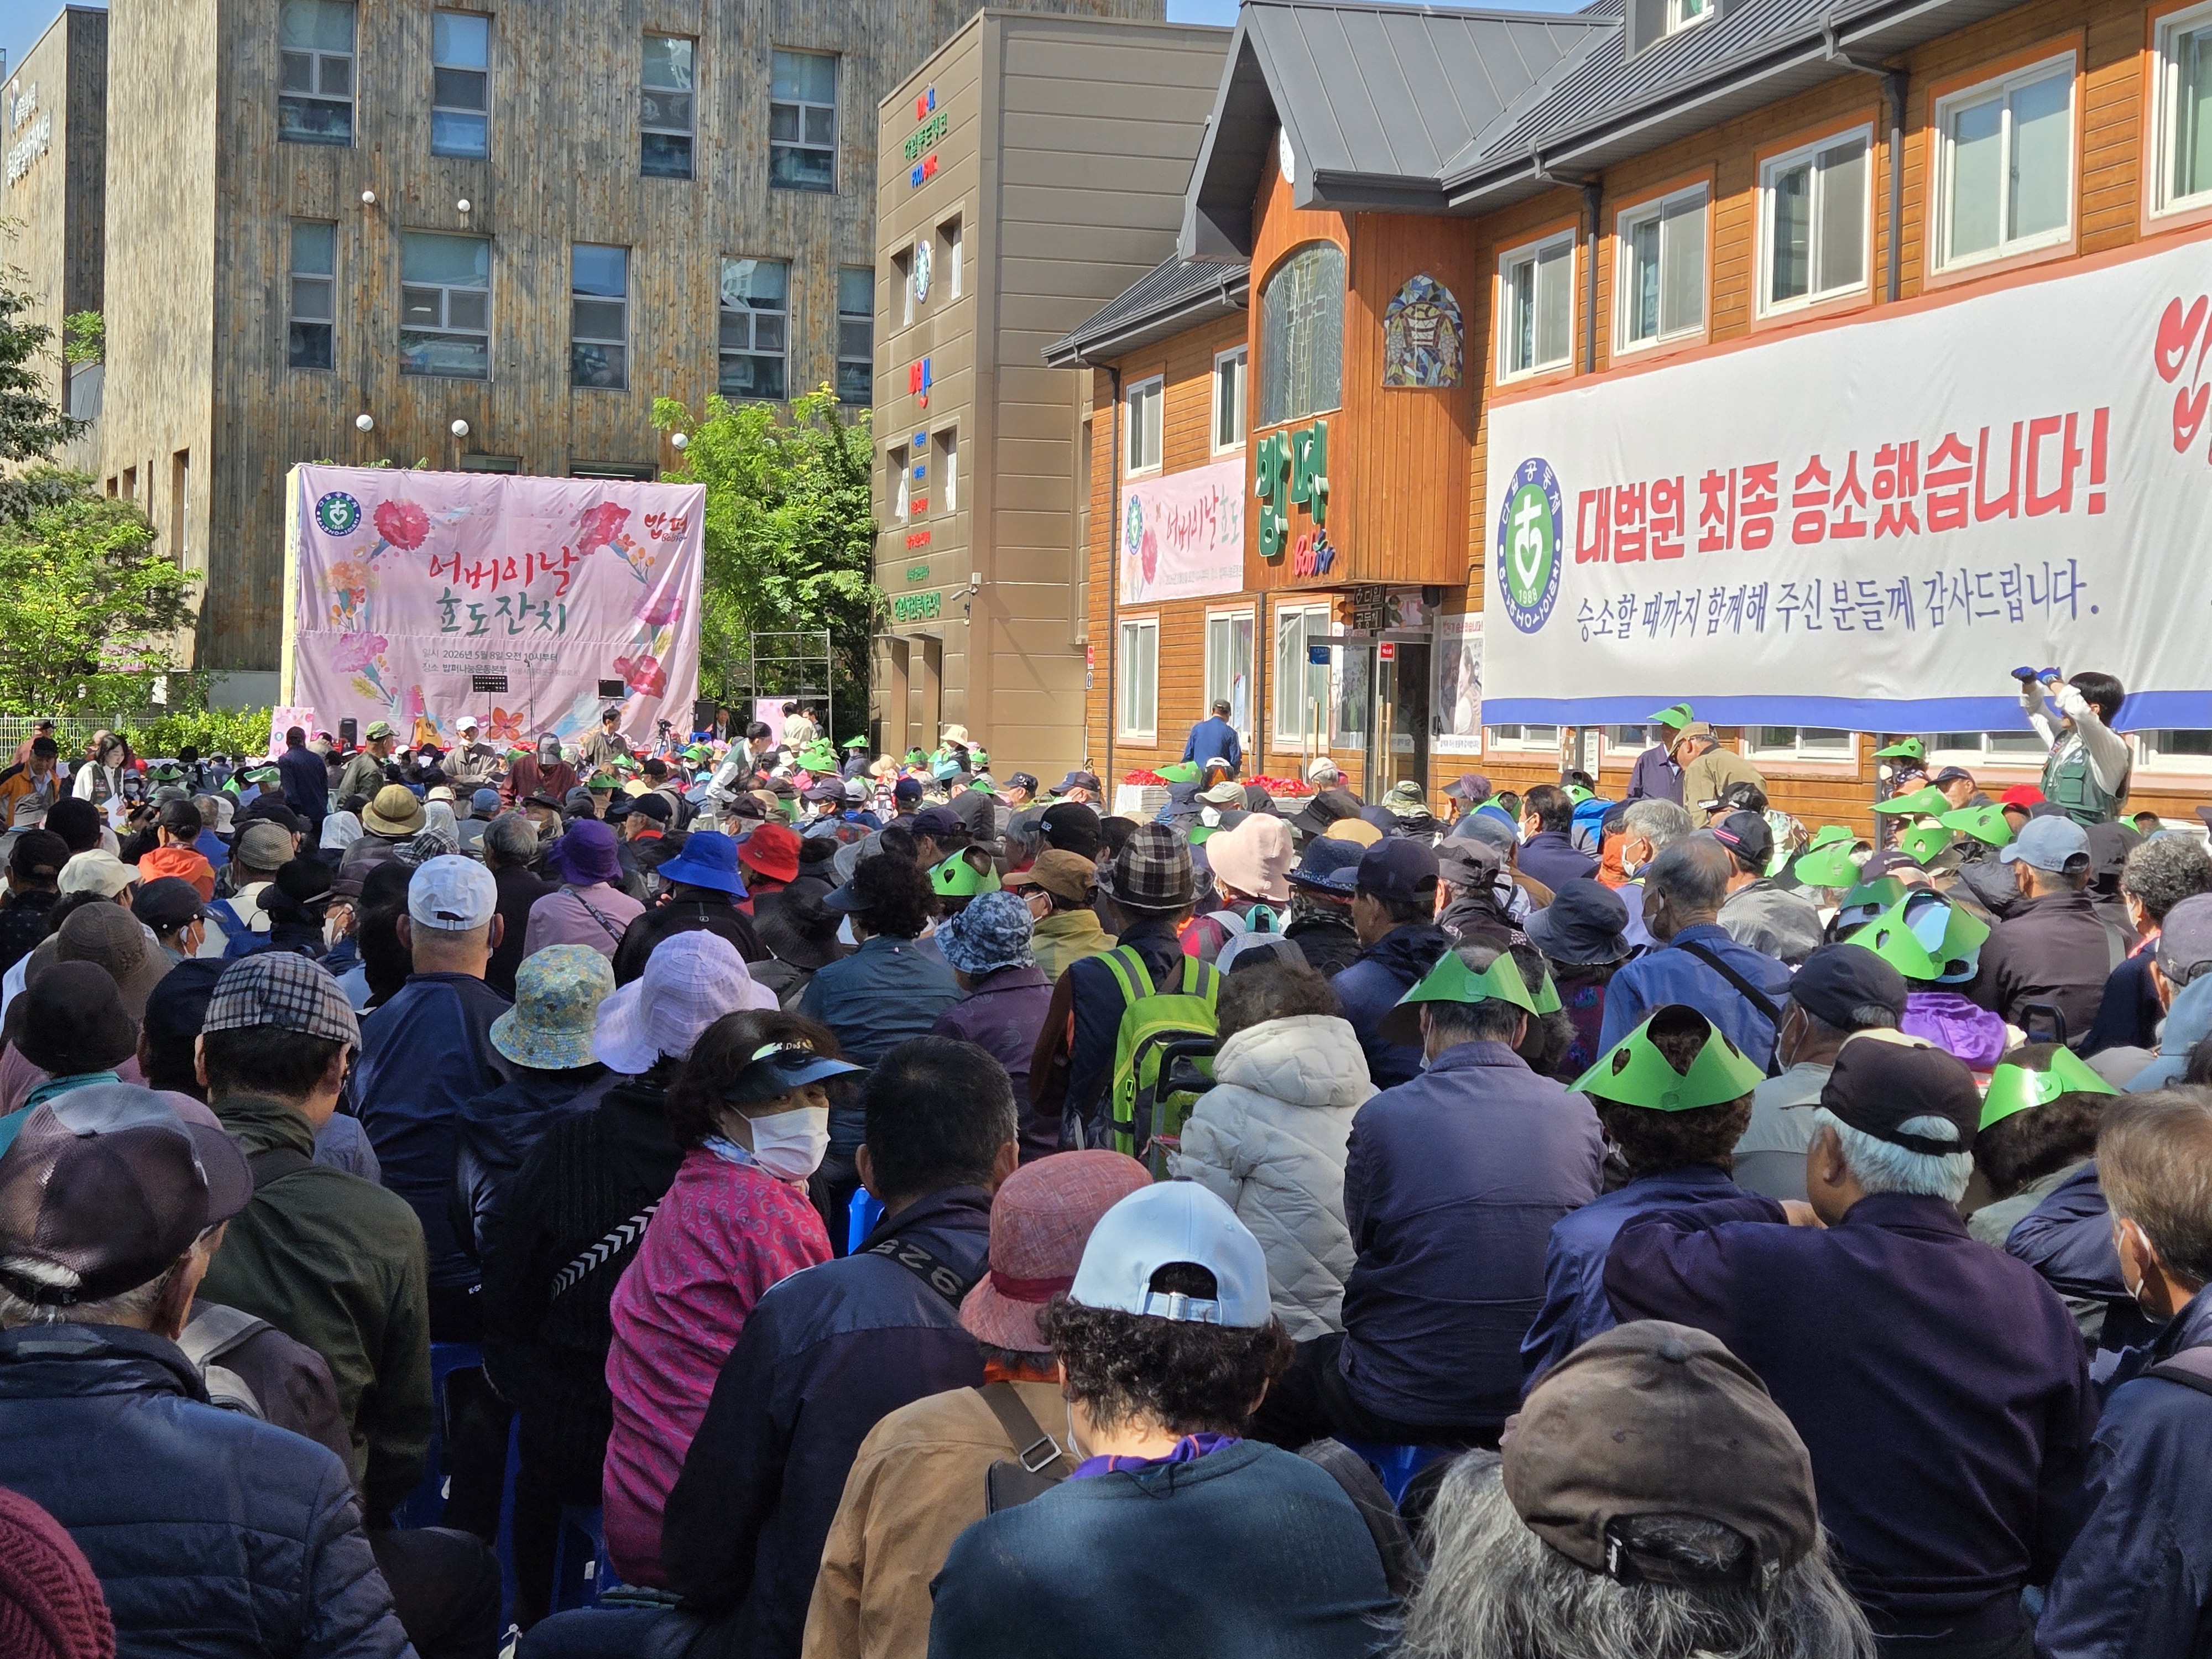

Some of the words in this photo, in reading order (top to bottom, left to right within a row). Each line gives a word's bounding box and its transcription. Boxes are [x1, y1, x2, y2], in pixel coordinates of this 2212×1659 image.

[1255, 420, 1329, 557] 밥퍼
[1502, 461, 1561, 524] 다일공동체
[1575, 476, 1684, 565] 대법원
[1698, 461, 1778, 552] 최종
[1791, 406, 2110, 545] 승소했습니다!
[430, 545, 580, 597] 어버이날
[1364, 586, 1382, 603] 다일
[1519, 587, 1538, 604] 1988
[437, 586, 567, 638] 효도잔치
[1356, 611, 1379, 629] 공동체
[1577, 593, 1637, 642] 승소할
[1642, 588, 1701, 639] 때까지
[1707, 581, 1768, 636] 함께해
[1775, 578, 1822, 633] 주신
[1830, 575, 1915, 632] 분들께
[1923, 558, 2099, 628] 감사드립니다.
[442, 650, 473, 660] 2026년
[474, 651, 488, 660] 5월
[489, 651, 503, 660] 8일
[505, 652, 521, 661] 오전
[524, 653, 557, 662] 10시부터
[442, 664, 508, 675] 밥퍼나눔운동본부
